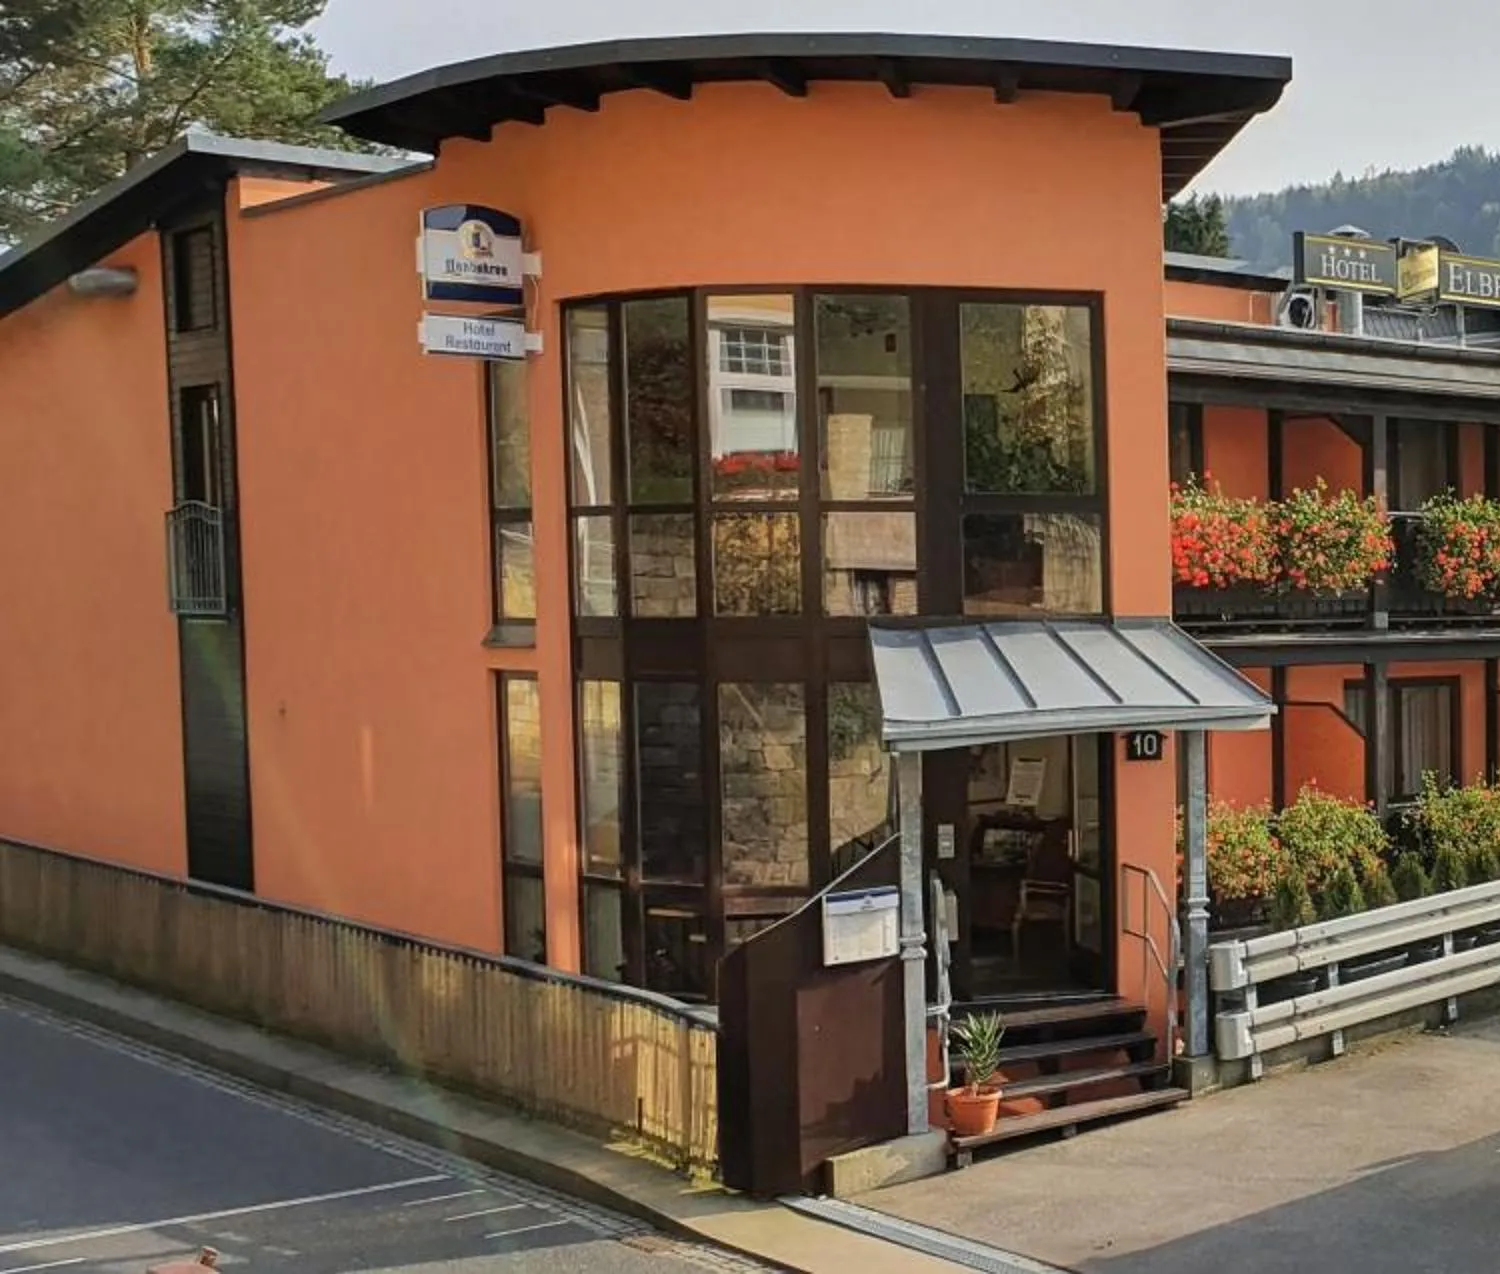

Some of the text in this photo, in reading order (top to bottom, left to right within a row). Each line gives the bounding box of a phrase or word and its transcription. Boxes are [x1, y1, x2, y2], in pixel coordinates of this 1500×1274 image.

[1320, 253, 1383, 283] HOTEL
[463, 321, 496, 335] Hotel
[445, 335, 512, 353] Restaurant
[1132, 733, 1157, 757] 10
